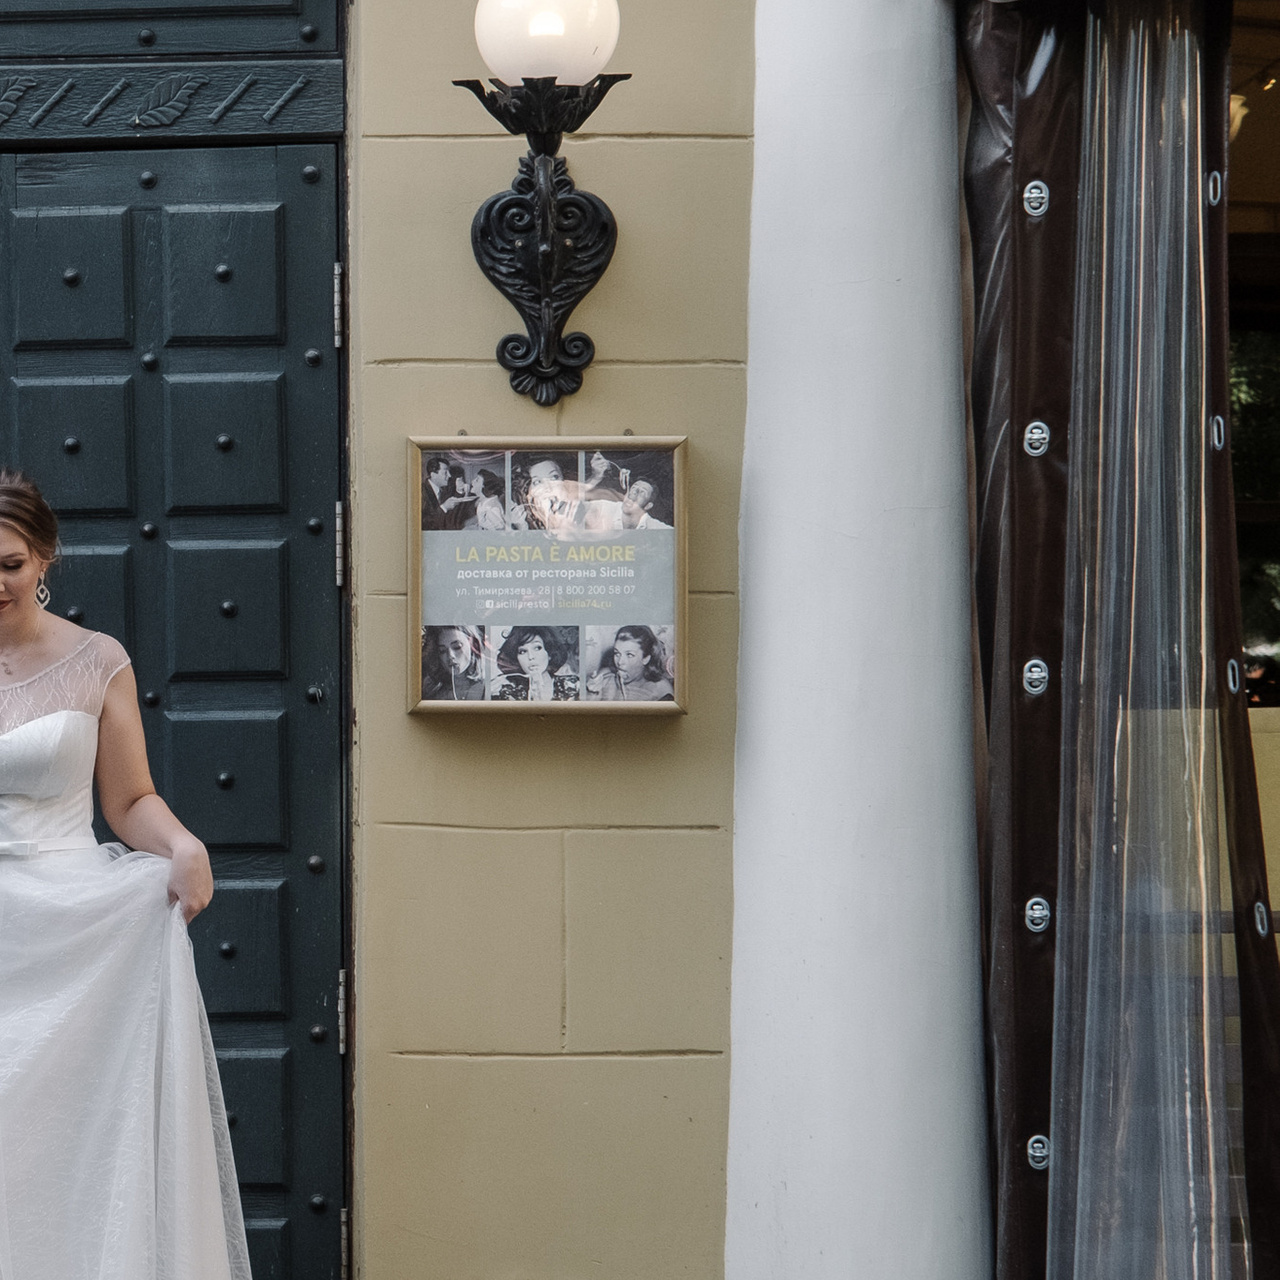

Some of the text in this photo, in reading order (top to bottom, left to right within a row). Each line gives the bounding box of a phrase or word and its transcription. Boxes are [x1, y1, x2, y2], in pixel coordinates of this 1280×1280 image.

[455, 542, 636, 563] LA PASTA È AMORE
[457, 566, 634, 580] доставка от ресторана Sicilia
[455, 588, 470, 597] ул.
[538, 586, 551, 595] 28
[556, 585, 563, 595] 8
[566, 585, 585, 595] 800
[588, 585, 606, 595] 200
[623, 585, 636, 595] 07
[557, 599, 612, 609] sicilia74.ru
